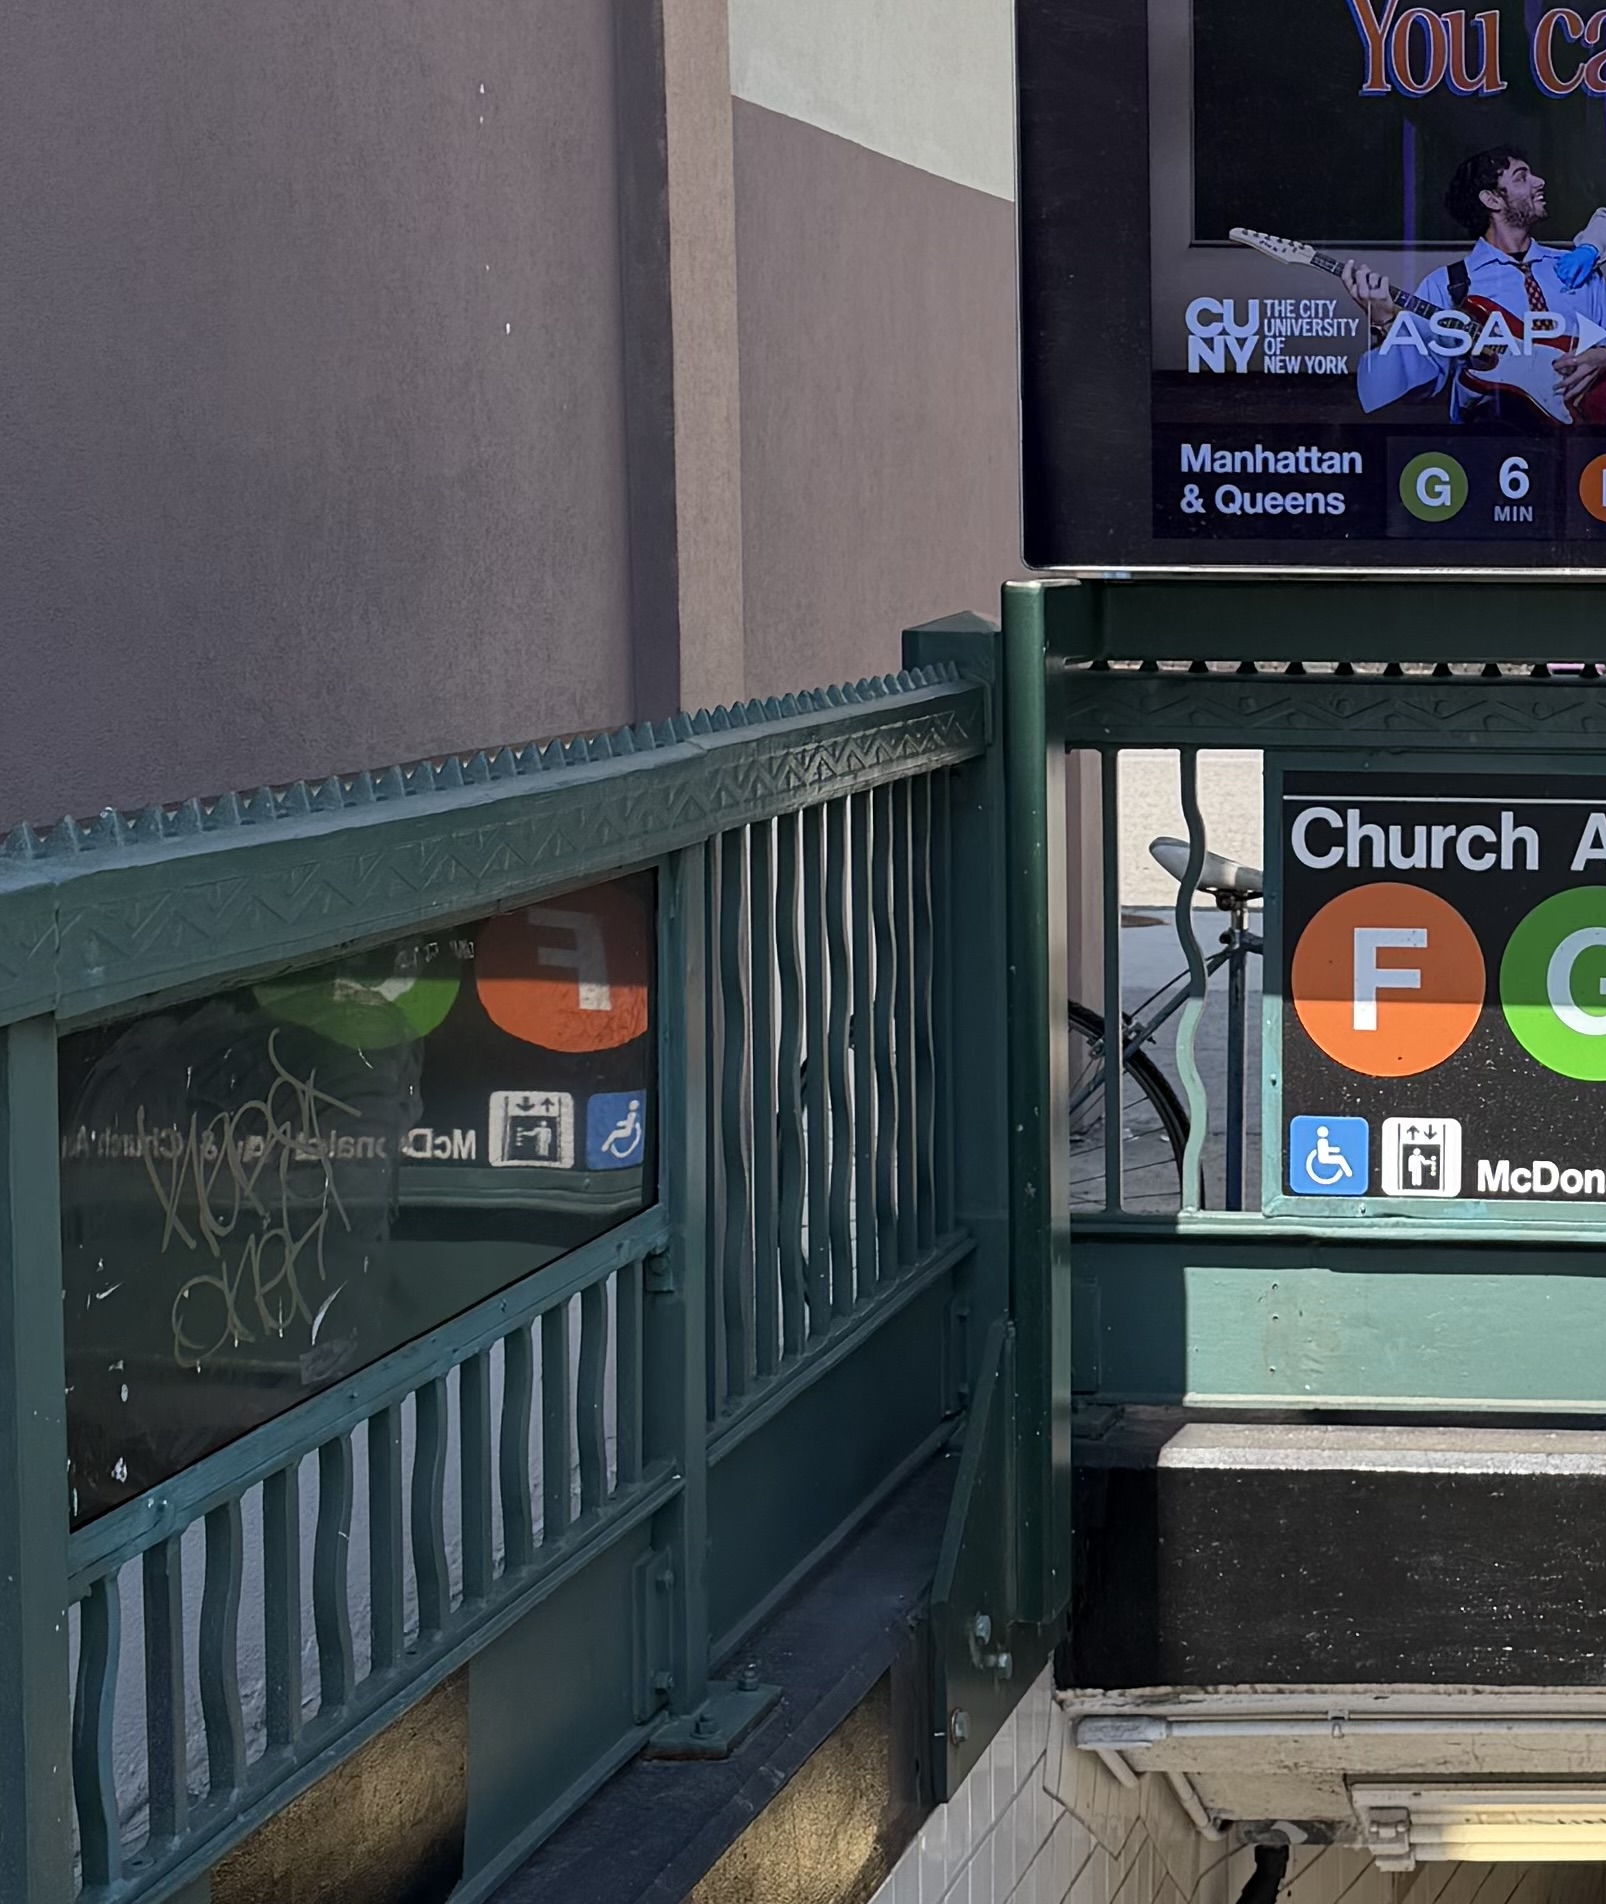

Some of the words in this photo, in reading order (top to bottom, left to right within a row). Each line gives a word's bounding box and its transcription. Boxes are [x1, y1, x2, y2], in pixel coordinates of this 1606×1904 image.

[1185, 297, 1260, 337] CU
[1263, 299, 1296, 318] THE
[1299, 299, 1337, 319] CITY
[1263, 318, 1360, 338] UNIVERSITY
[1378, 309, 1567, 357] ASAP
[1187, 335, 1260, 374] NY
[1263, 337, 1286, 355] OF
[1263, 356, 1303, 374] NEW
[1305, 355, 1349, 375] YORK
[1180, 443, 1363, 475] Manhattan
[1415, 466, 1453, 507] G
[1498, 456, 1531, 500] 6
[1180, 485, 1205, 514] &
[1213, 484, 1347, 516] Queens
[1494, 505, 1534, 522] MIN
[1291, 807, 1539, 872] Church
[1353, 927, 1429, 1031] F
